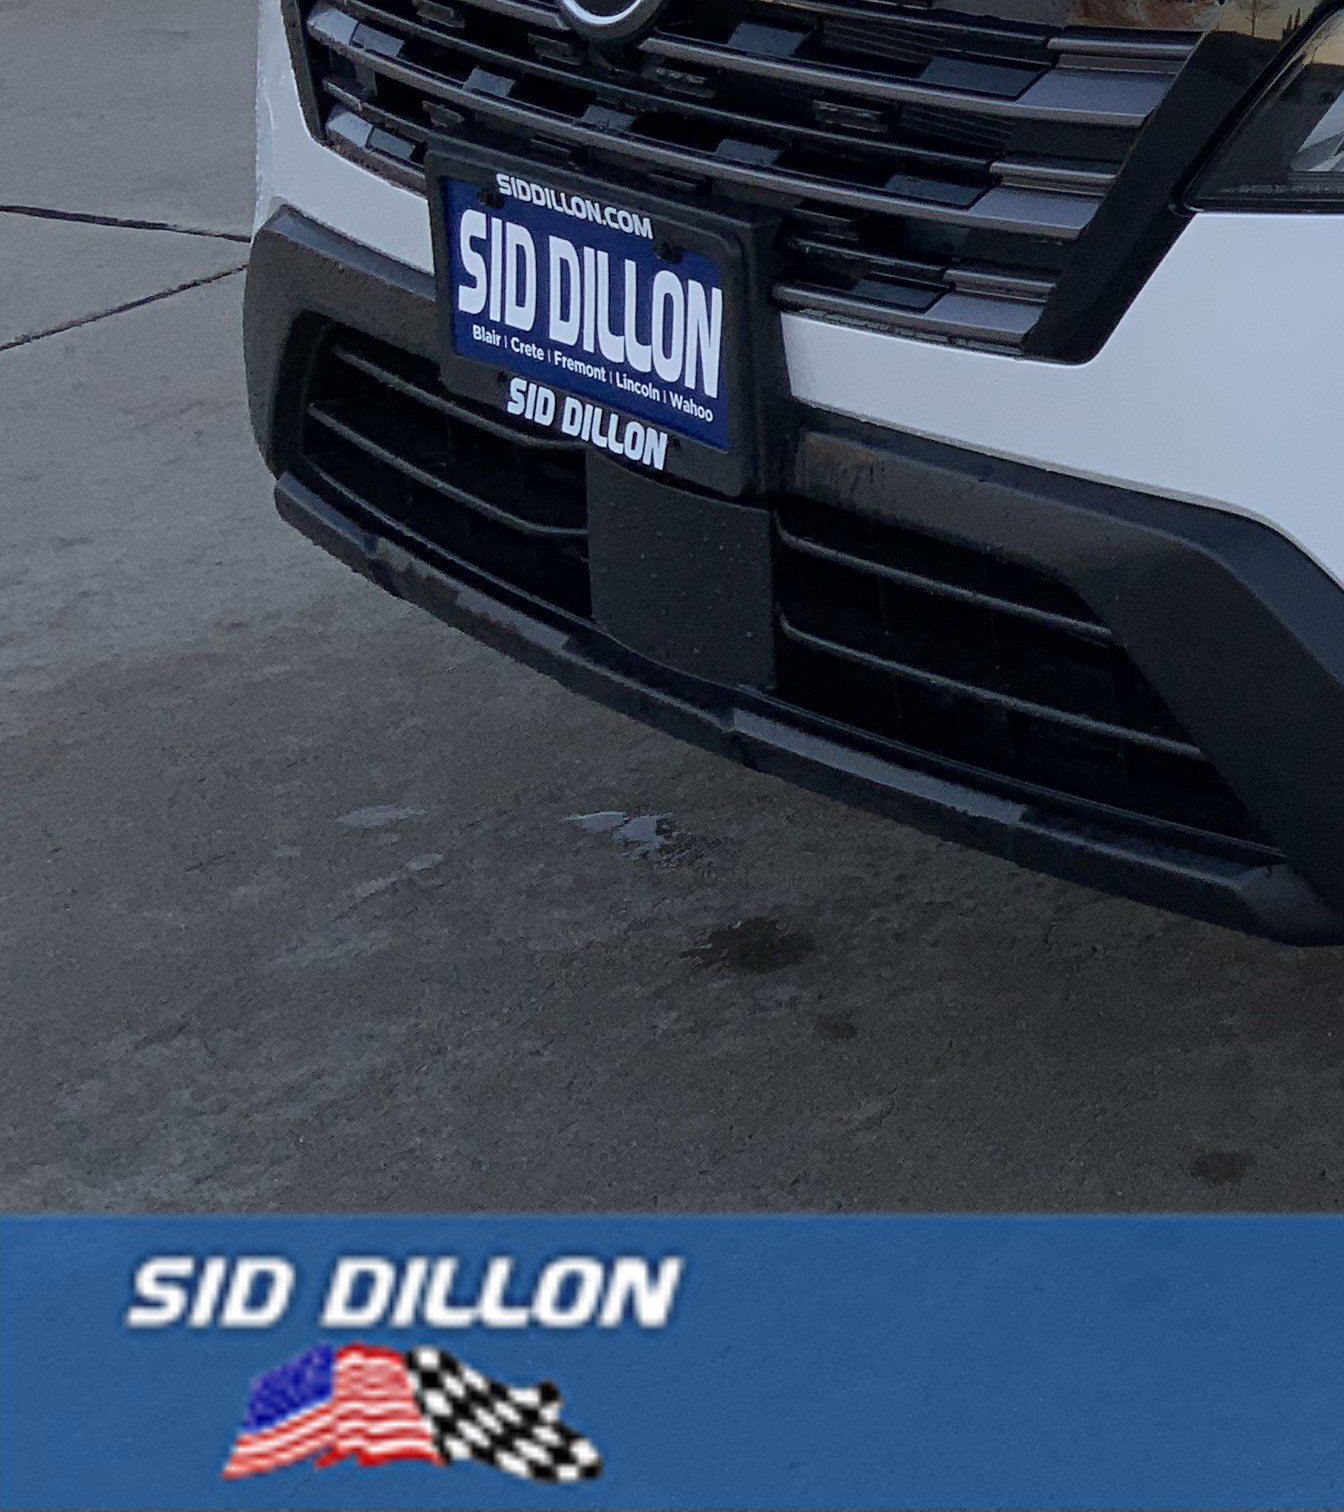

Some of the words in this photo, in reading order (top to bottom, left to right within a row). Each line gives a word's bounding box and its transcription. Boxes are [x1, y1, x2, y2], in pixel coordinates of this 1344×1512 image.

[496, 172, 653, 240] SIDDILLON.COM
[458, 208, 537, 332] SID
[549, 235, 723, 399] DILLON
[472, 324, 502, 347] Blair
[510, 336, 545, 361] Crete
[553, 350, 607, 383] Fremont
[615, 371, 661, 402] Lincoln
[669, 390, 714, 423] Wahoo
[507, 377, 555, 426] SID
[562, 396, 668, 471] DILLON
